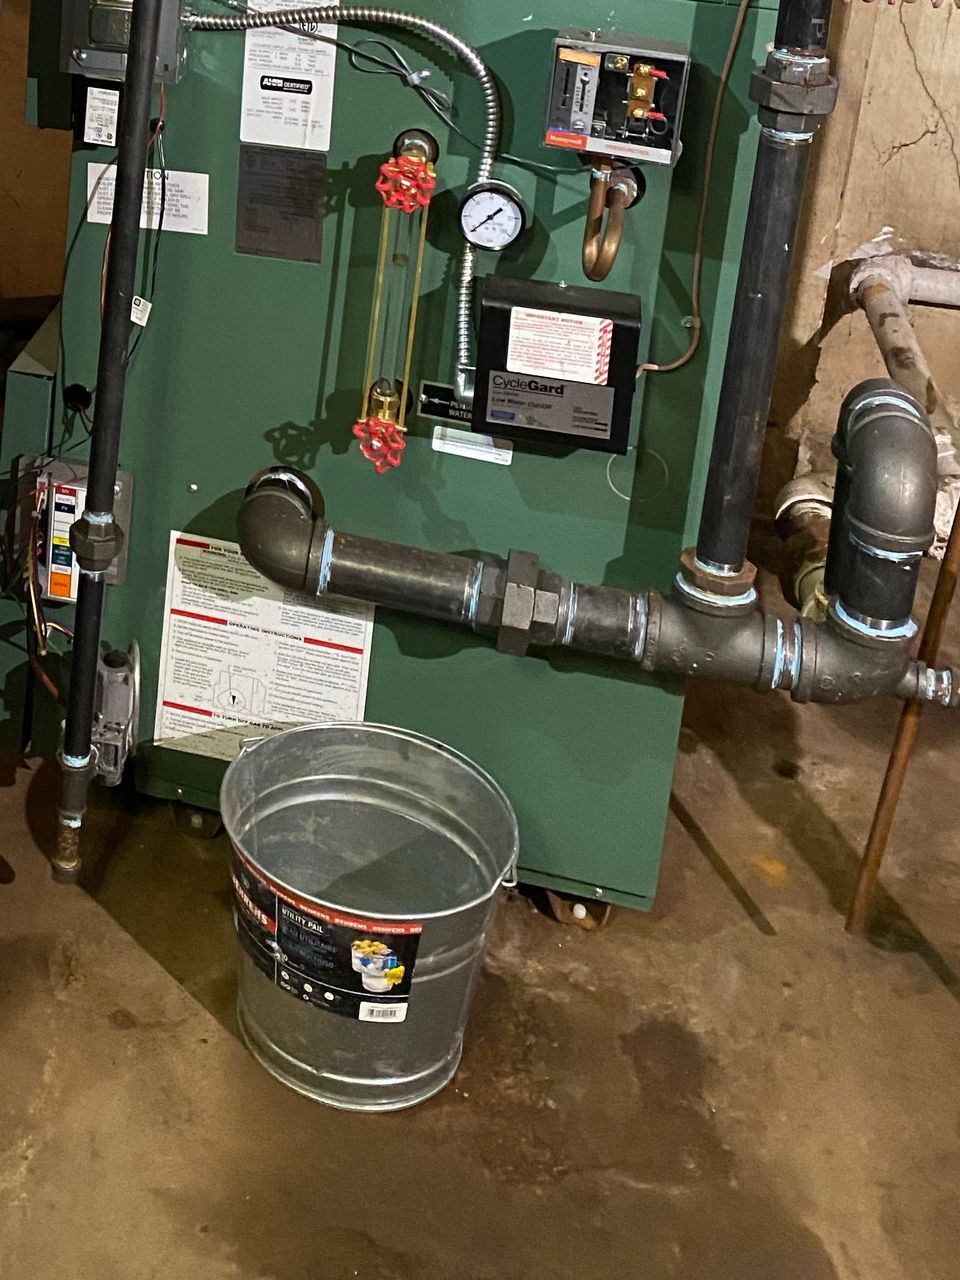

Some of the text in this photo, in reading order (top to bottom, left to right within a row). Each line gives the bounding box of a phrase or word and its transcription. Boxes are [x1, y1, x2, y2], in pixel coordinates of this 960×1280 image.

[492, 374, 565, 395] CycleGard
[505, 398, 527, 406] Water
[449, 409, 472, 419] WATER
[229, 621, 302, 641] OPERATING INSTRUCTIONS
[281, 907, 324, 934] UTILITY PAIL
